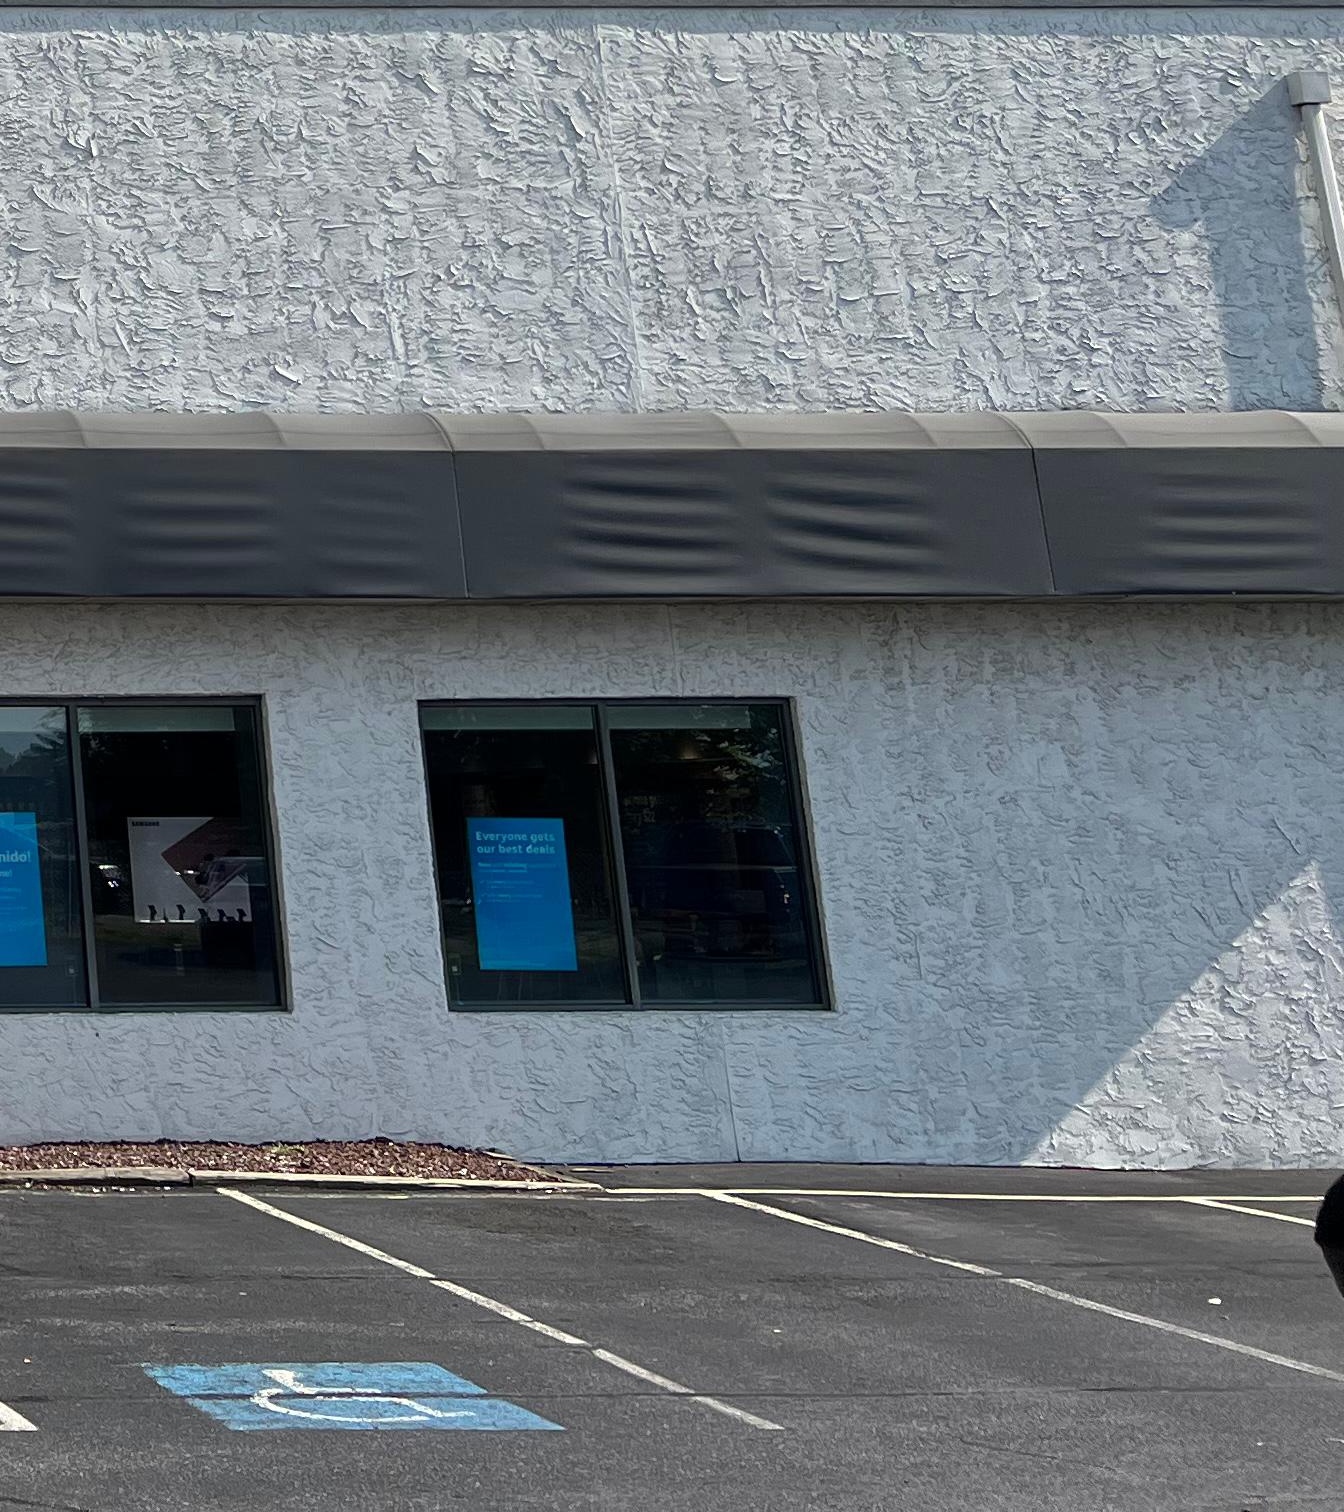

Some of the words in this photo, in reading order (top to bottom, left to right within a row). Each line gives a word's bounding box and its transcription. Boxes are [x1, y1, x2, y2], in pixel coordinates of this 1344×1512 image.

[475, 831, 529, 843] Everyone
[530, 833, 556, 843] gets
[476, 845, 496, 854] our
[498, 843, 524, 854] best
[525, 844, 556, 854] deals
